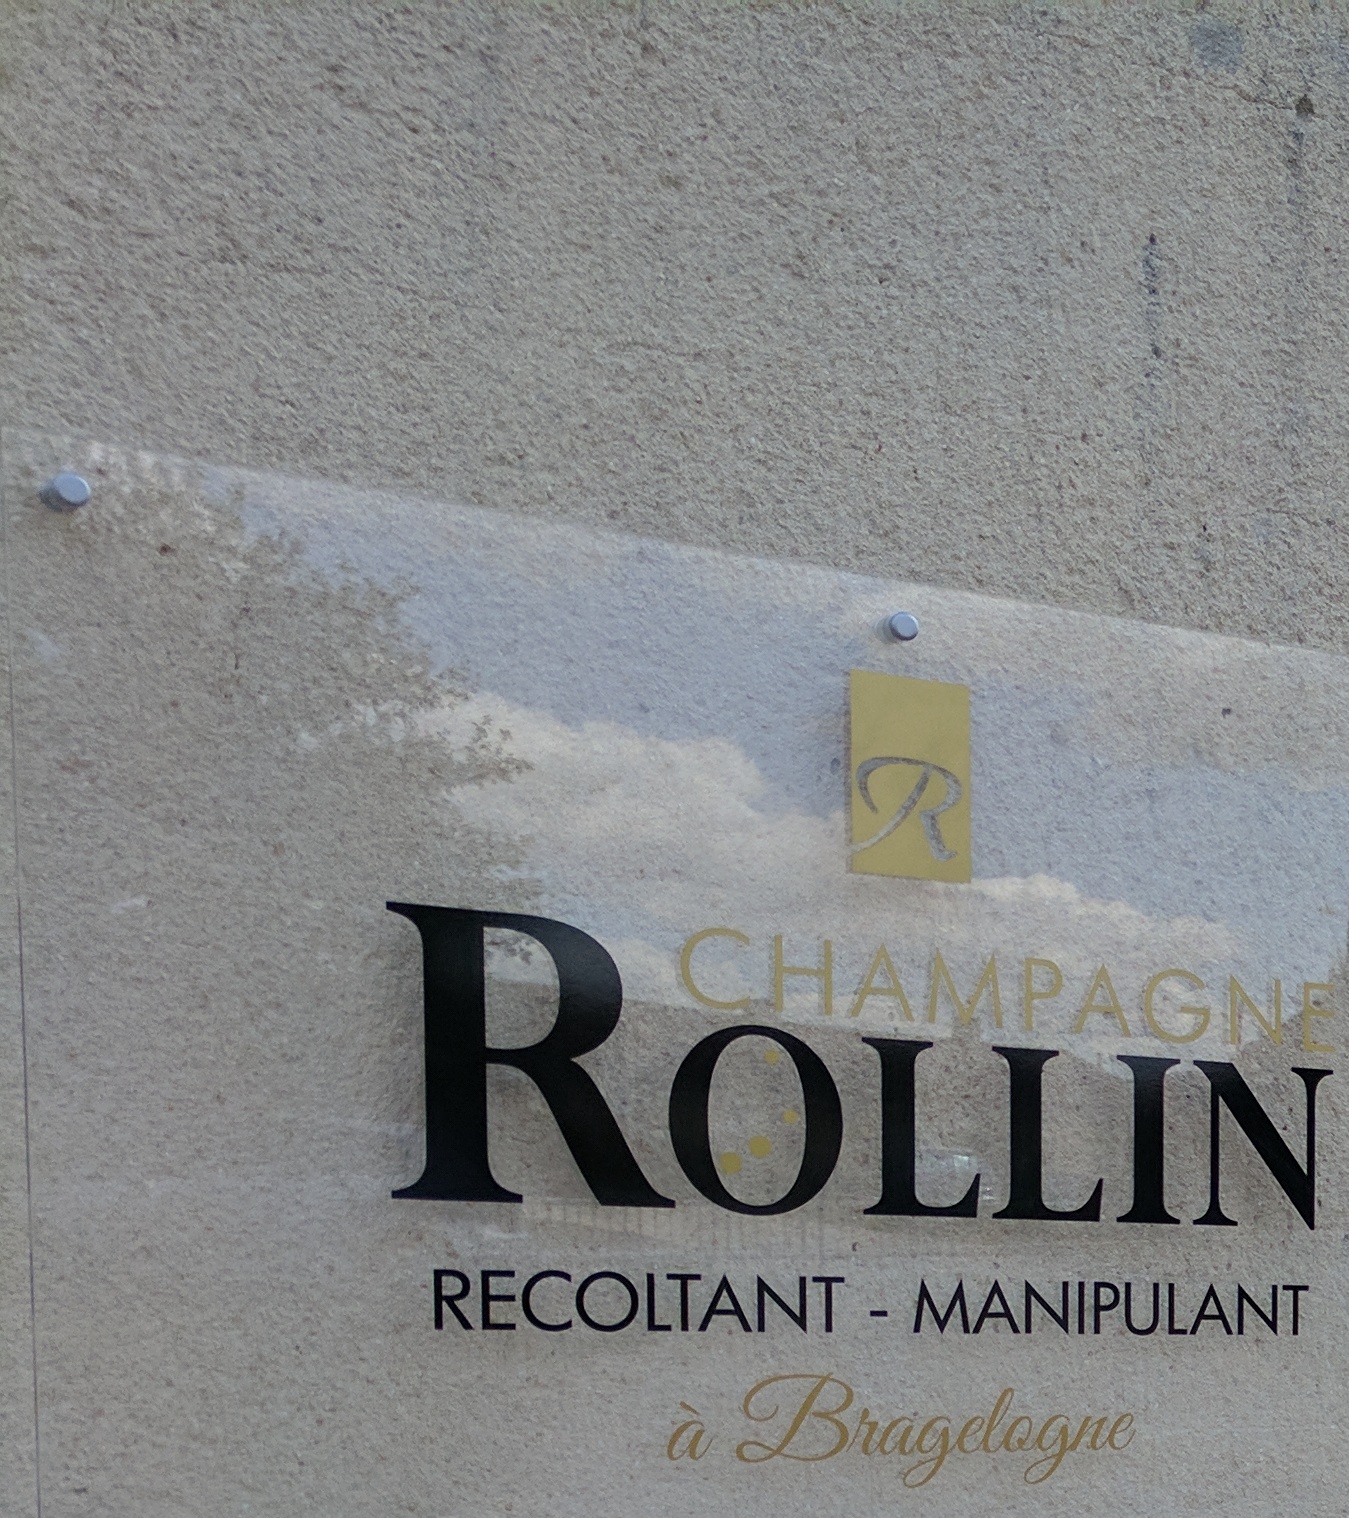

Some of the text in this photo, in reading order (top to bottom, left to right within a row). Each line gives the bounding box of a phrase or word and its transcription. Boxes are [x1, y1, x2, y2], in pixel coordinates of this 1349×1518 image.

[679, 927, 1338, 1054] CHAMPAGNE
[386, 900, 1335, 1231] ROLLIN
[433, 1268, 845, 1335] RECOLTANT
[912, 1279, 1309, 1337] MANIPULANT
[665, 1371, 1137, 1489] à Bragelogne
